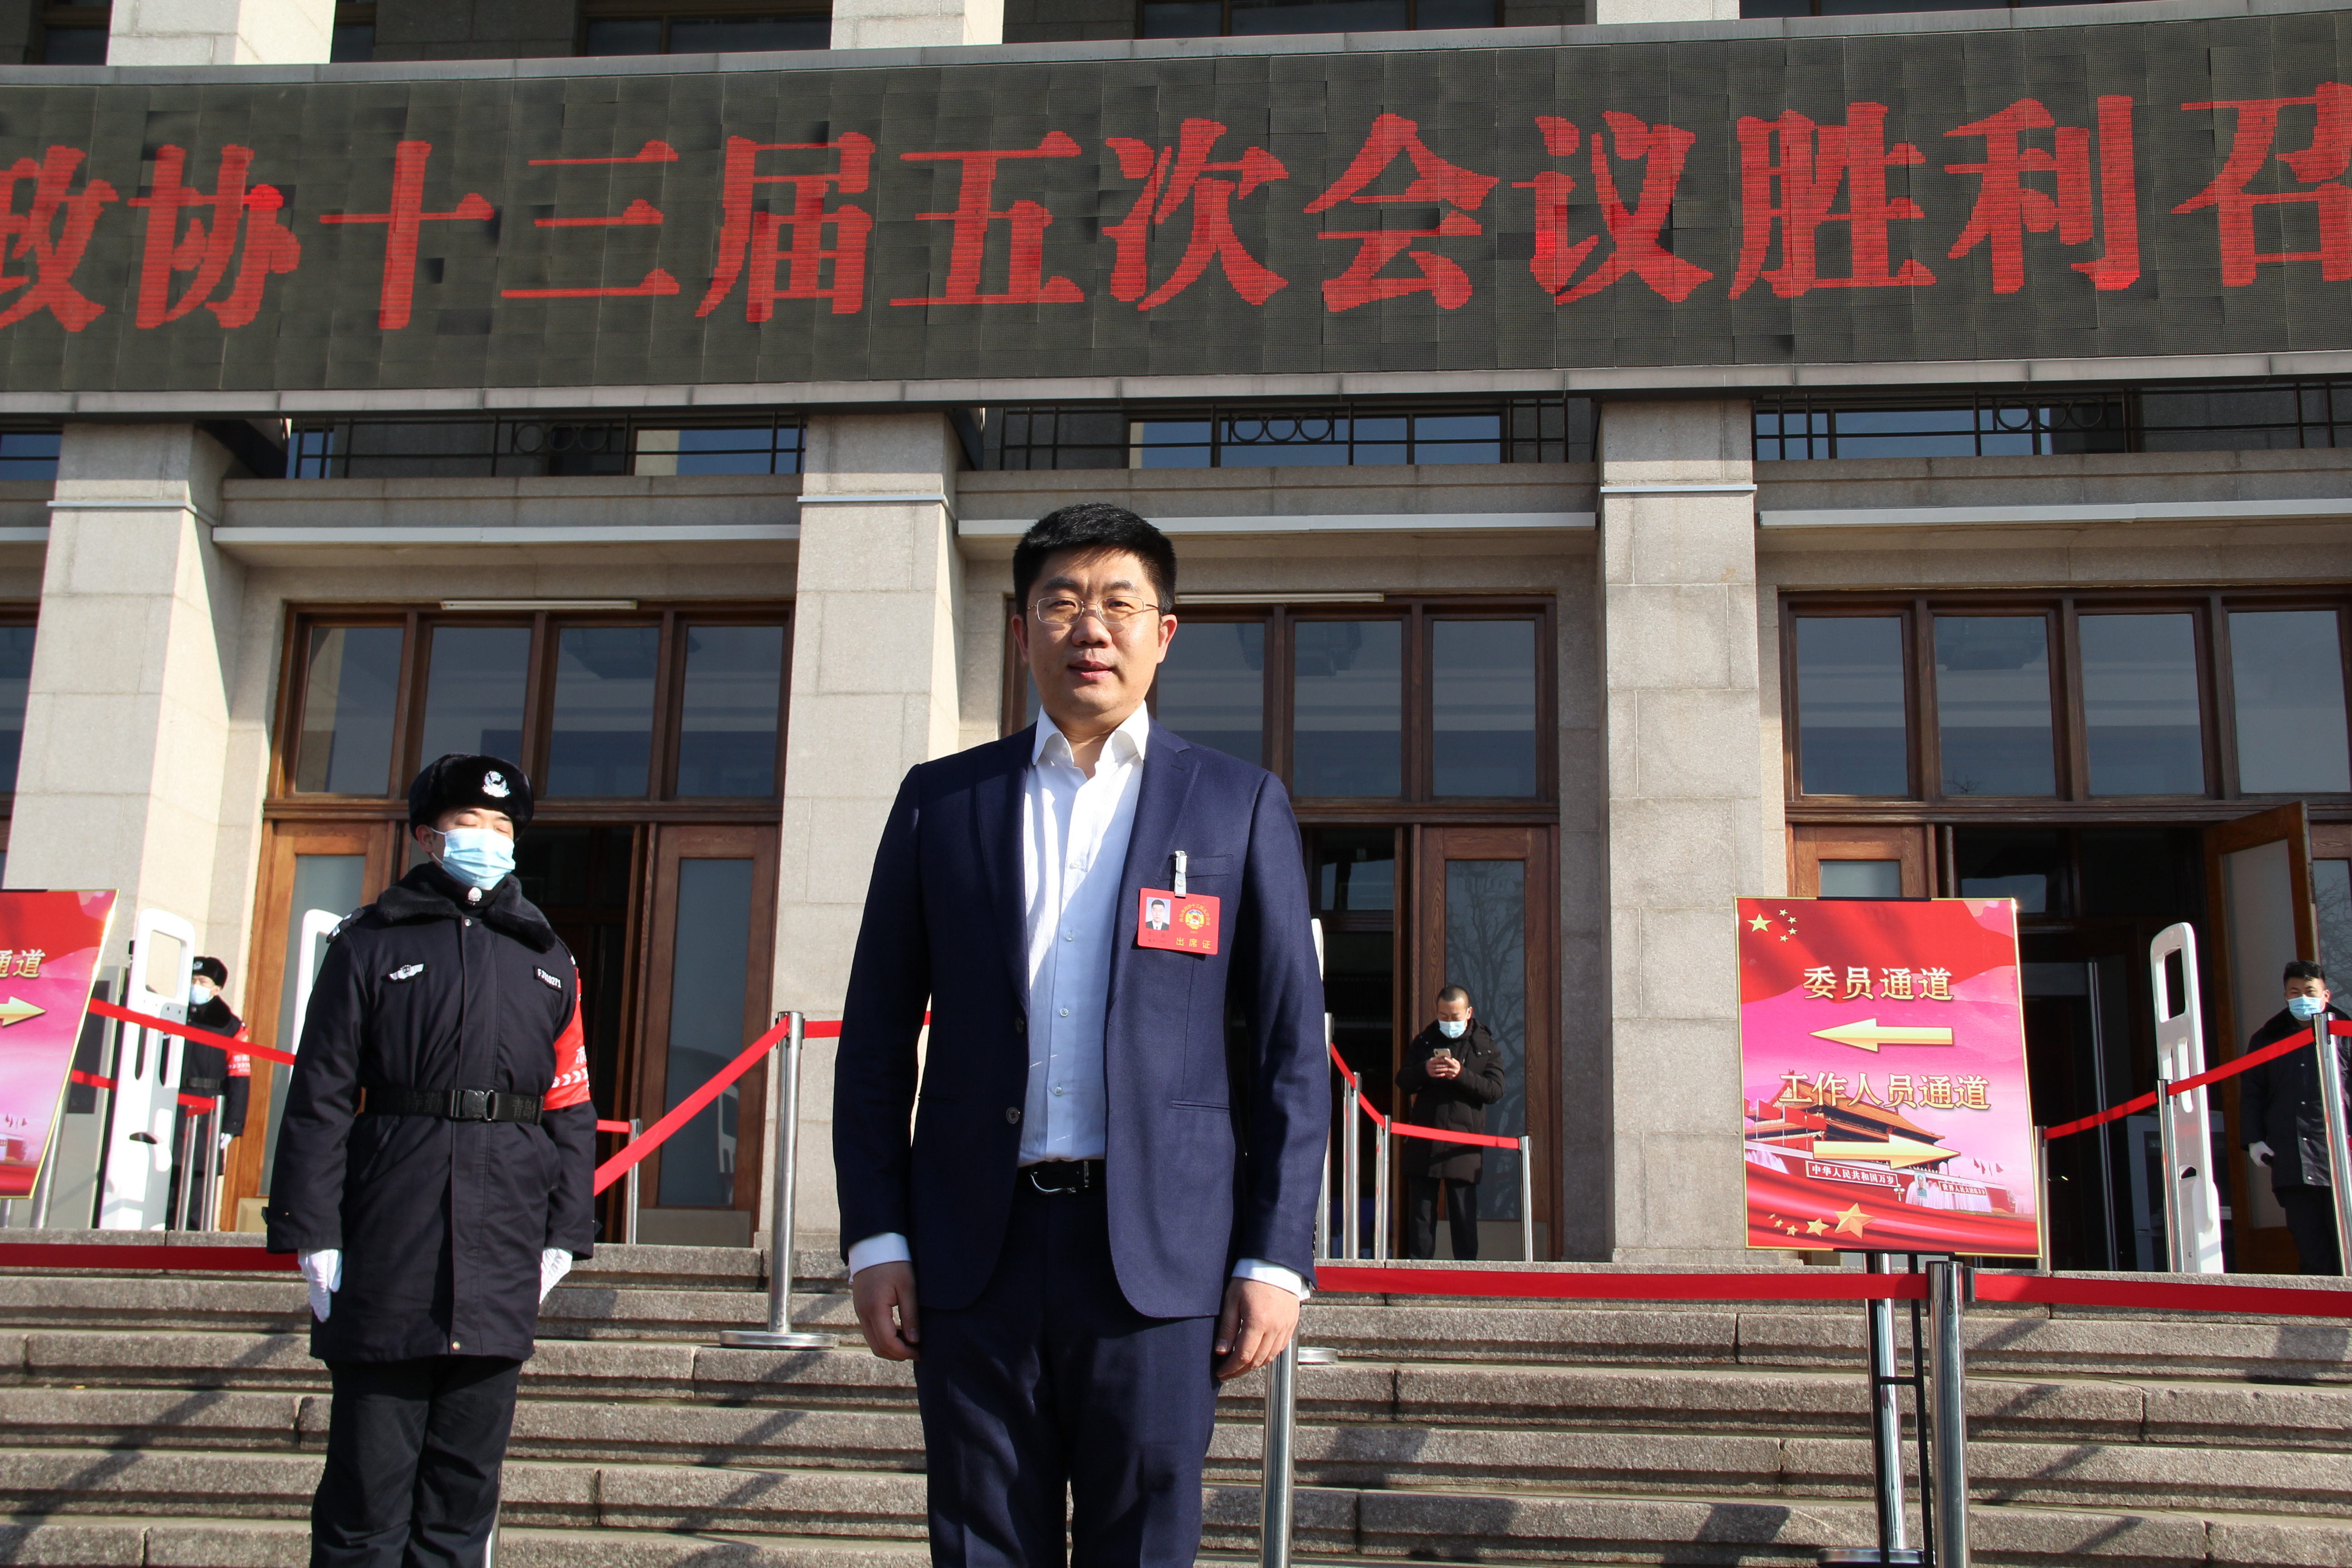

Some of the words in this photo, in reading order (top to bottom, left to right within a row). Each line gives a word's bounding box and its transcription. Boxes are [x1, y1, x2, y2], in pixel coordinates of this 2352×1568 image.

[0, 82, 2352, 332] 政协十三届五次会议胜利召
[1176, 937, 1210, 949] 出席证
[1803, 965, 1954, 1000] 委员通道
[1779, 1071, 1991, 1110] 工作人员通道
[1812, 1164, 1894, 1185] 中华人民共和国万岁
